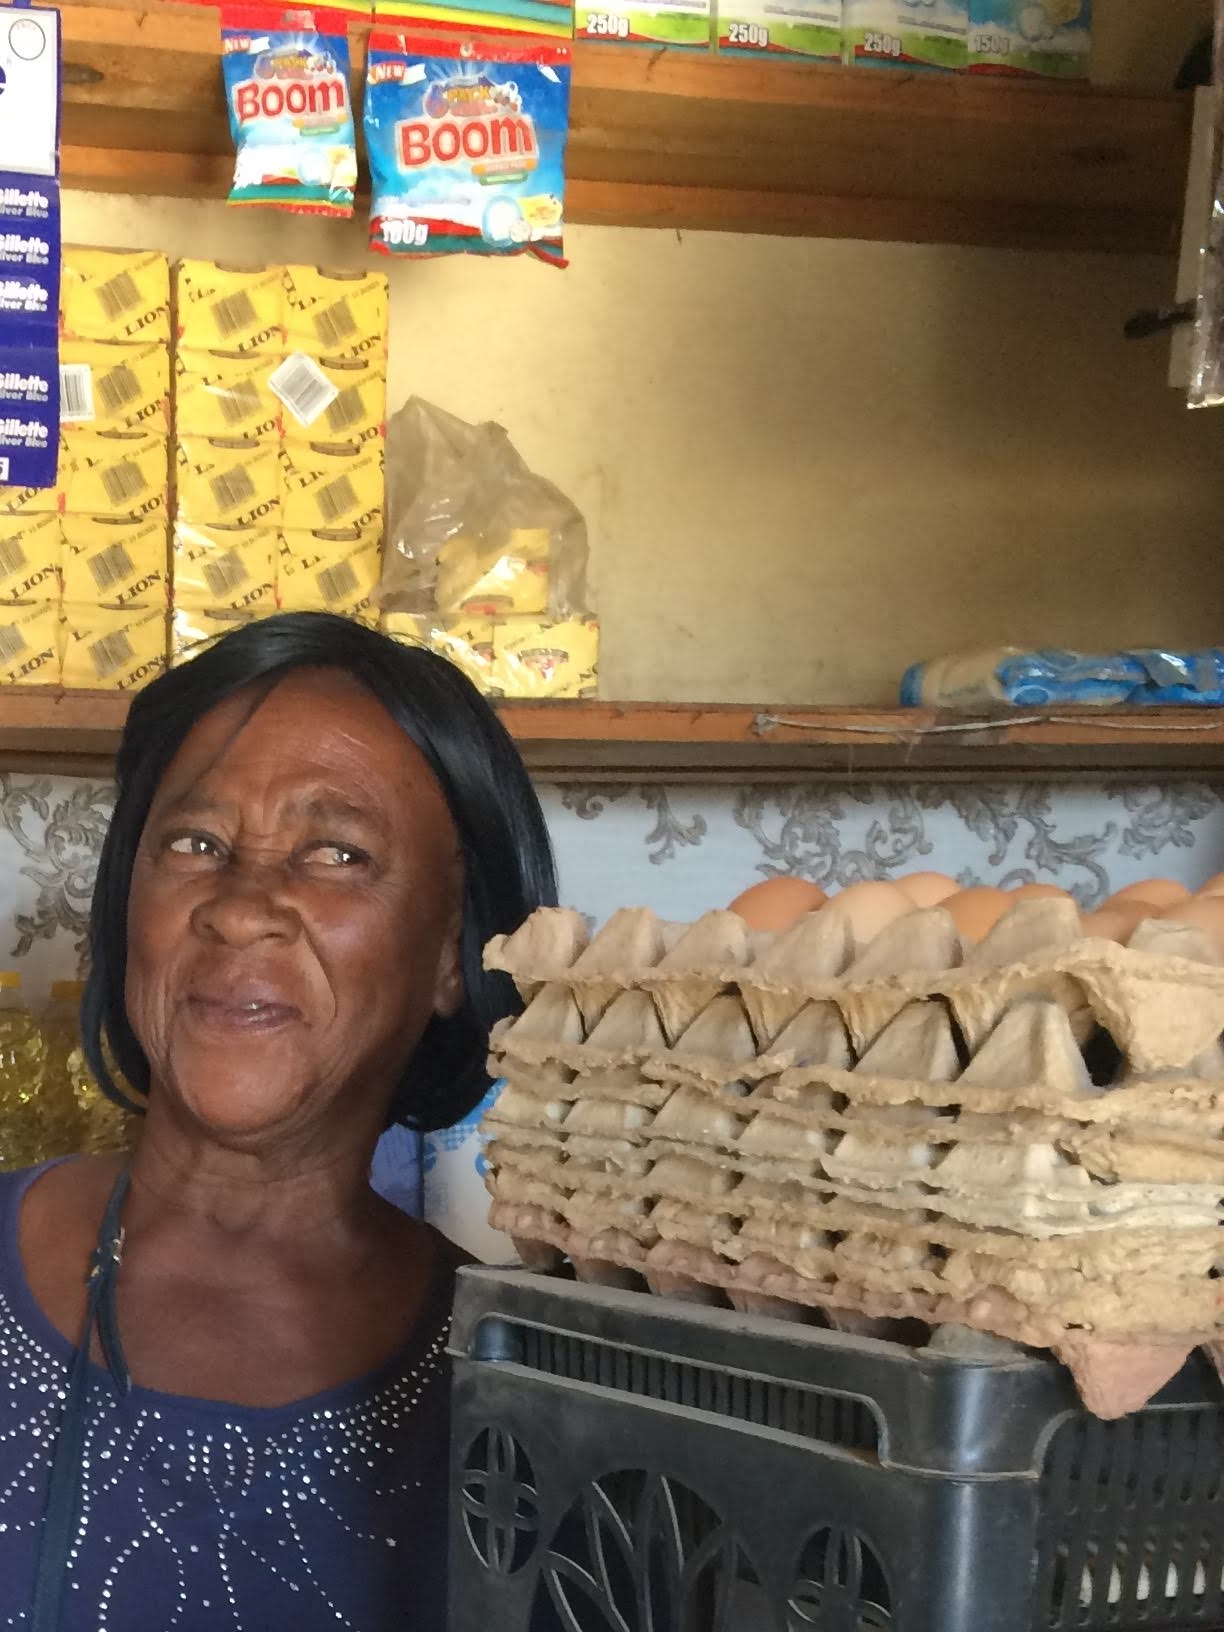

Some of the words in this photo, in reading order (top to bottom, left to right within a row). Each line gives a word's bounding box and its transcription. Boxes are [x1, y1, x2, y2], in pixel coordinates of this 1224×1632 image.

[586, 14, 630, 37] 250g
[728, 23, 769, 47] 250g
[863, 32, 901, 57] 250g
[379, 219, 429, 245] 100g
[243, 420, 276, 439] LIO
[237, 496, 281, 526] LION
[351, 508, 381, 532] ION
[10, 562, 56, 599] LION
[116, 569, 162, 605] LION
[231, 583, 274, 610] LION
[7, 647, 55, 682] LION
